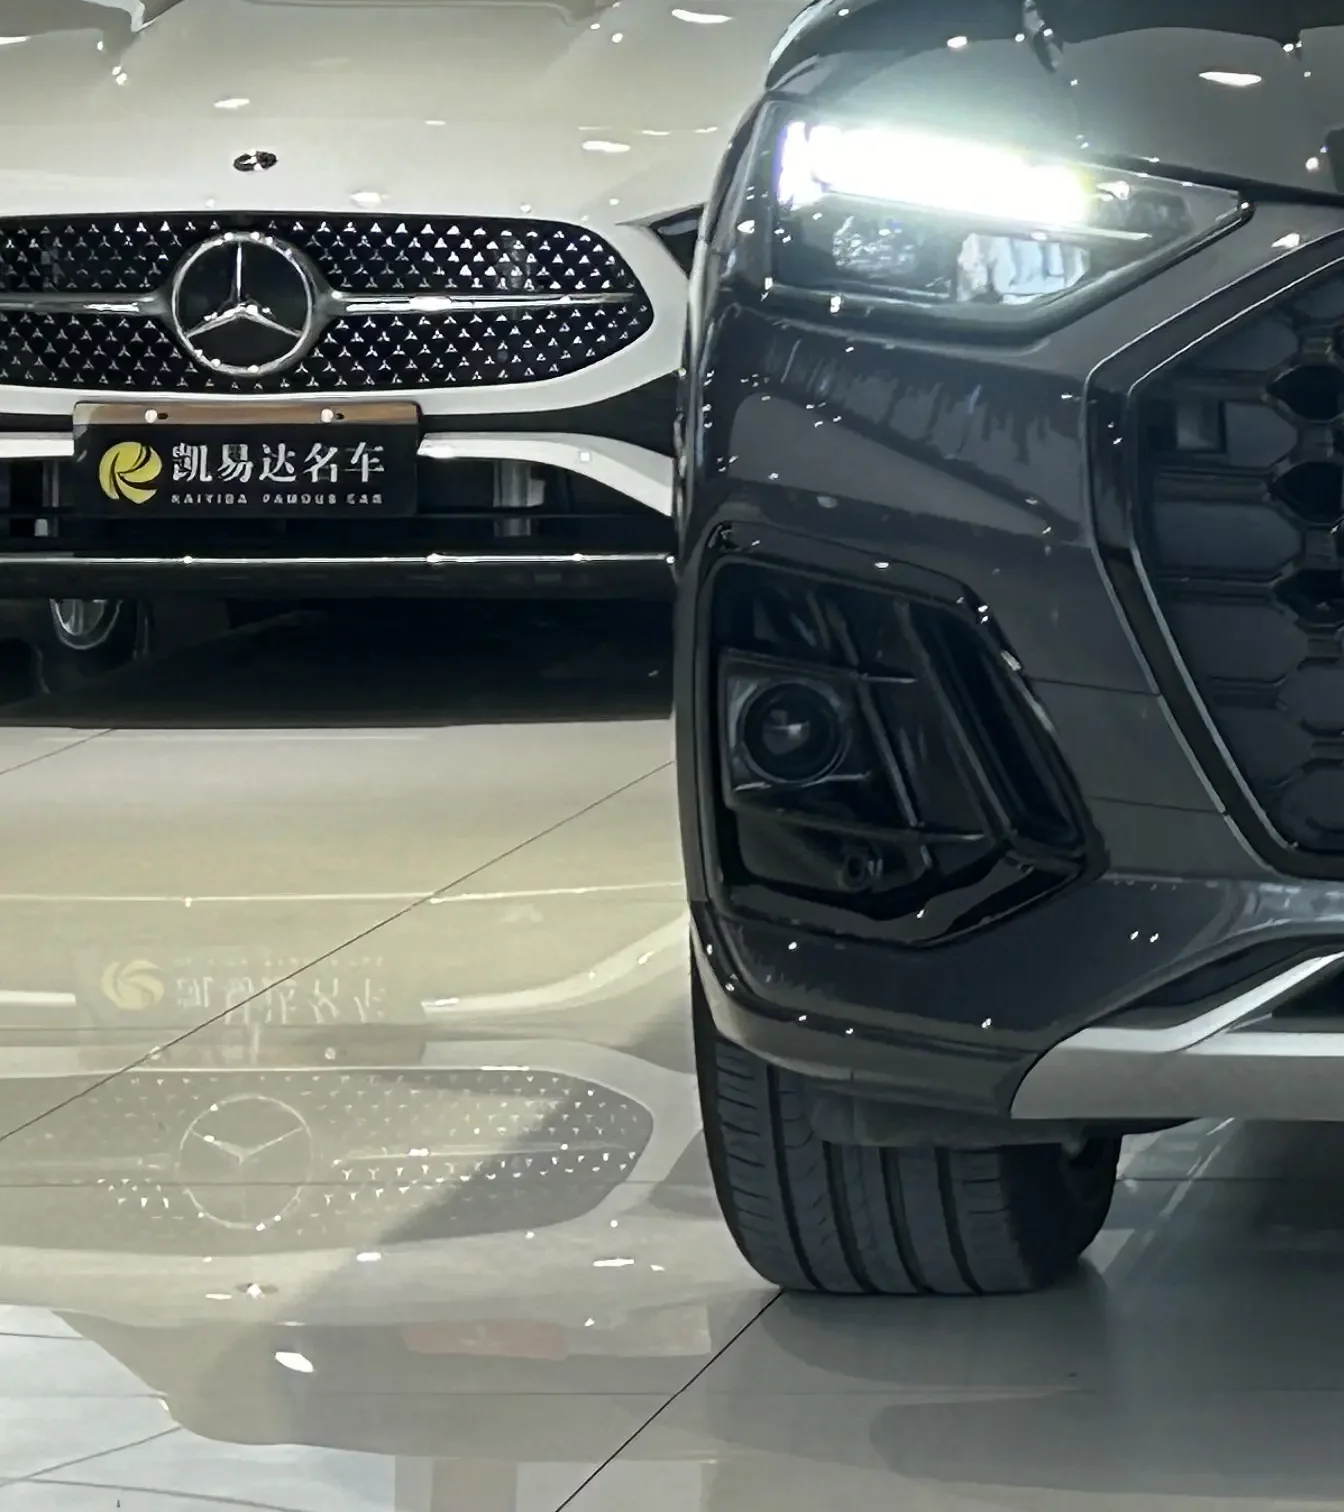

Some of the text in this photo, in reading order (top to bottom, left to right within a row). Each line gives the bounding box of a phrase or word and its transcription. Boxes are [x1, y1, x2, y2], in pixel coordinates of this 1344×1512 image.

[171, 441, 385, 484] 凯易达名车
